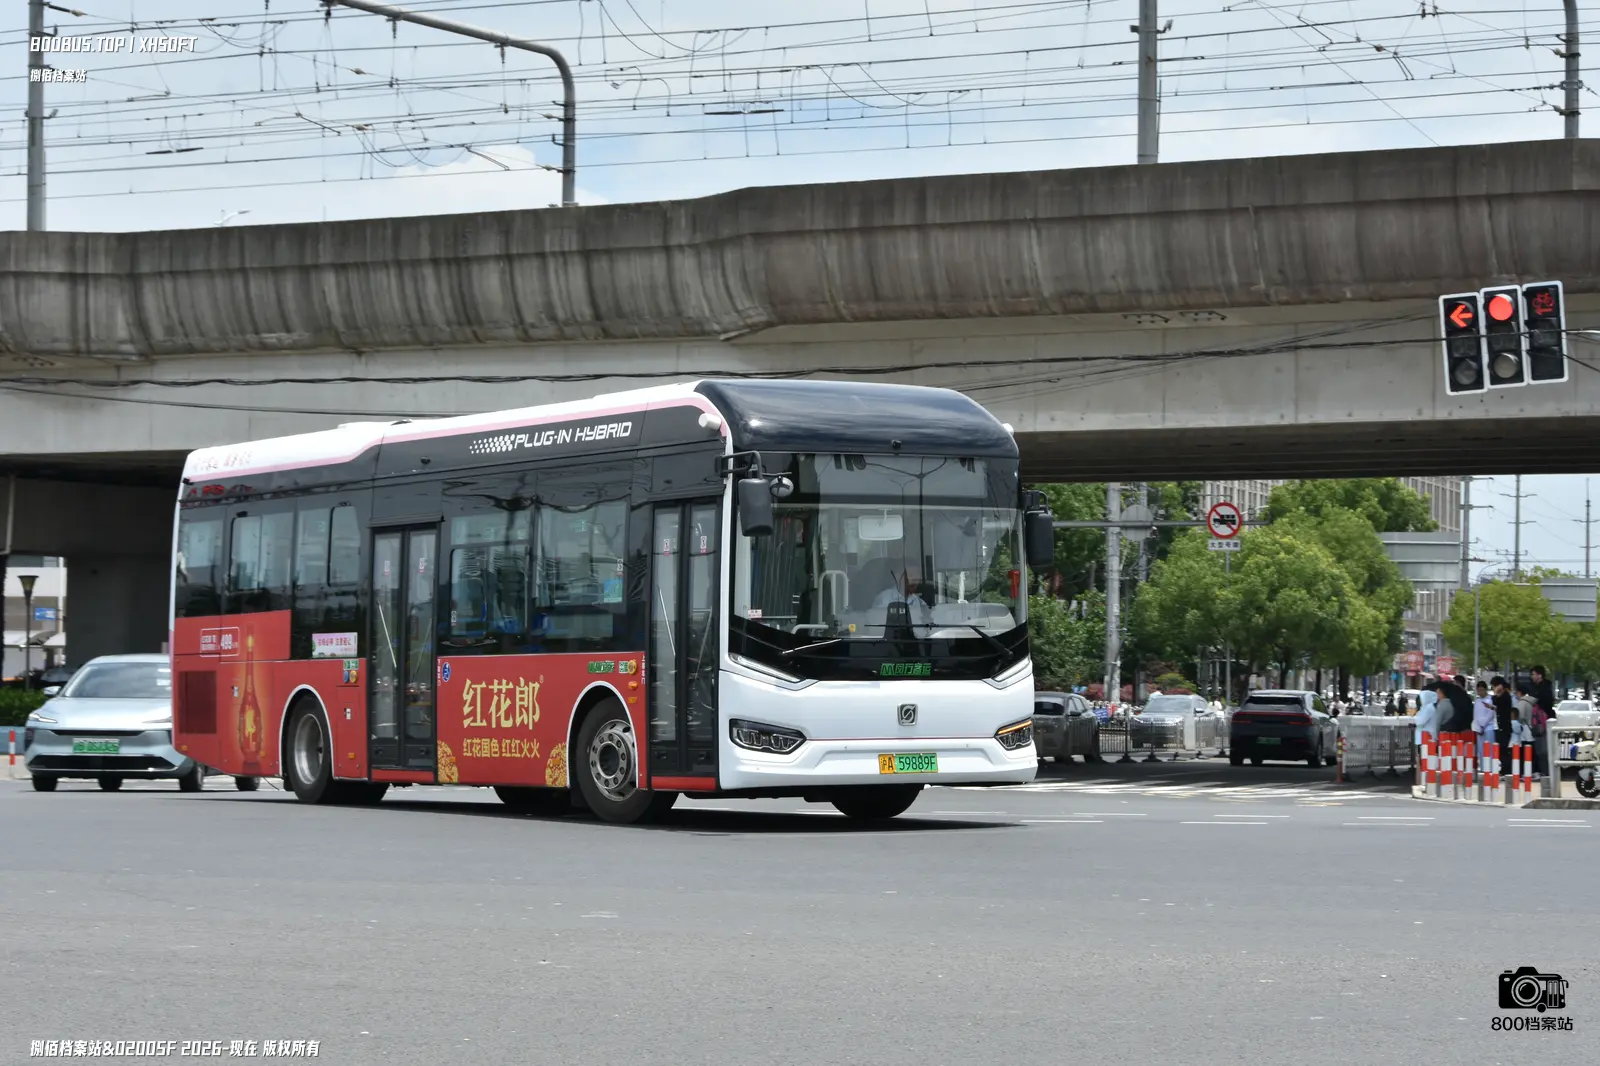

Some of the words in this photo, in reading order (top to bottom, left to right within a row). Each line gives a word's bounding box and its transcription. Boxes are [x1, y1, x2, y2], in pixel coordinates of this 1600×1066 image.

[514, 428, 572, 449] PLUG-IN
[575, 421, 632, 442] HYBRID
[462, 677, 541, 730] 红花郎
[463, 738, 500, 757] 红花国色
[501, 737, 541, 758] 红红火火
[898, 755, 936, 771] 59889F
